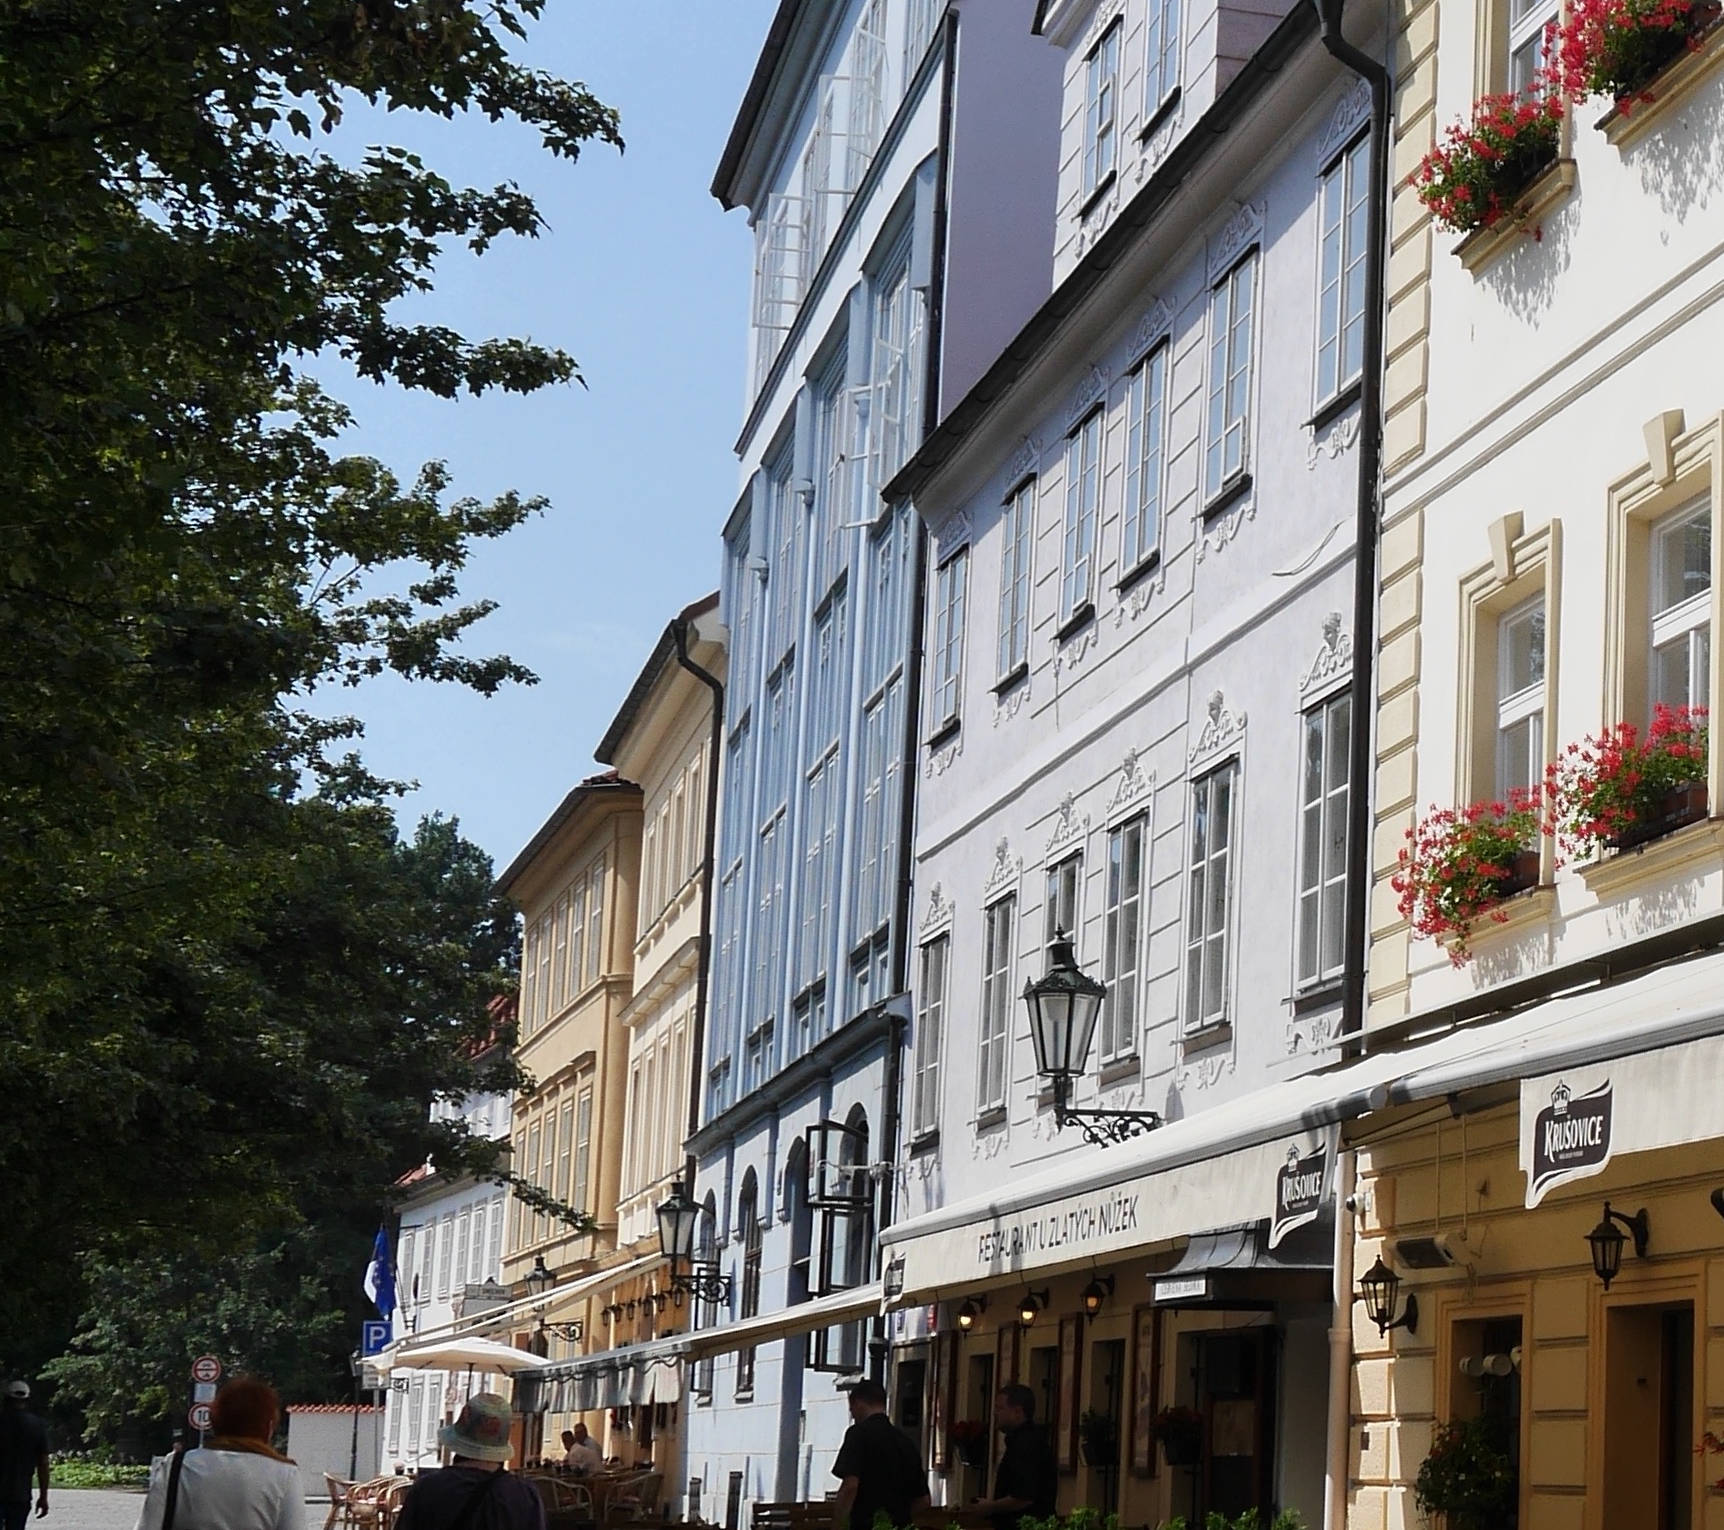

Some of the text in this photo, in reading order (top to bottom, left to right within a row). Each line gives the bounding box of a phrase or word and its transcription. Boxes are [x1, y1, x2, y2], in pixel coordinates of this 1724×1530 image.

[1543, 1114, 1604, 1163] KRUŠOVICE
[978, 1191, 1139, 1264] RESTAURANT U ZLATÝCH NŮŽEK
